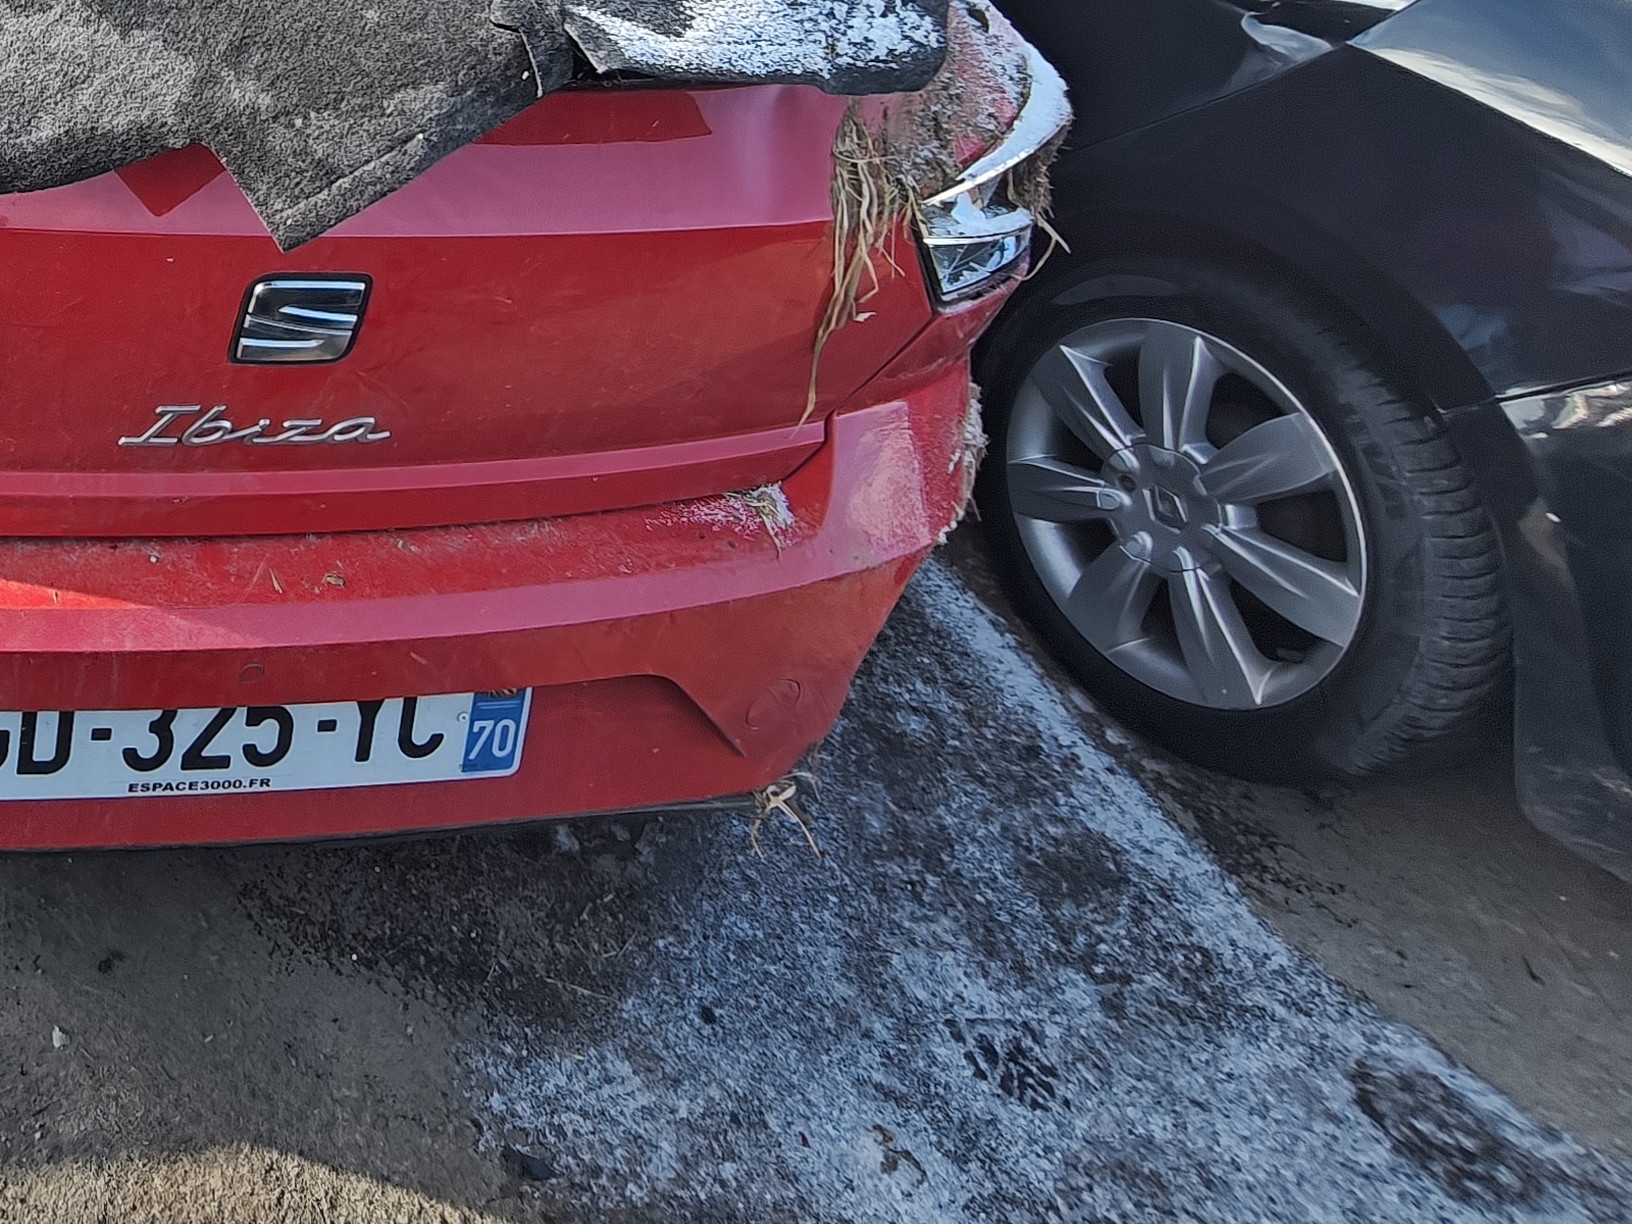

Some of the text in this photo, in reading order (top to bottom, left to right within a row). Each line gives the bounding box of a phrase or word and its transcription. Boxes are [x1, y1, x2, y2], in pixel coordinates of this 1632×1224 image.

[116, 403, 392, 448] Ibiza
[467, 718, 517, 760] 70
[127, 777, 272, 794] ESPACE3000.FR
